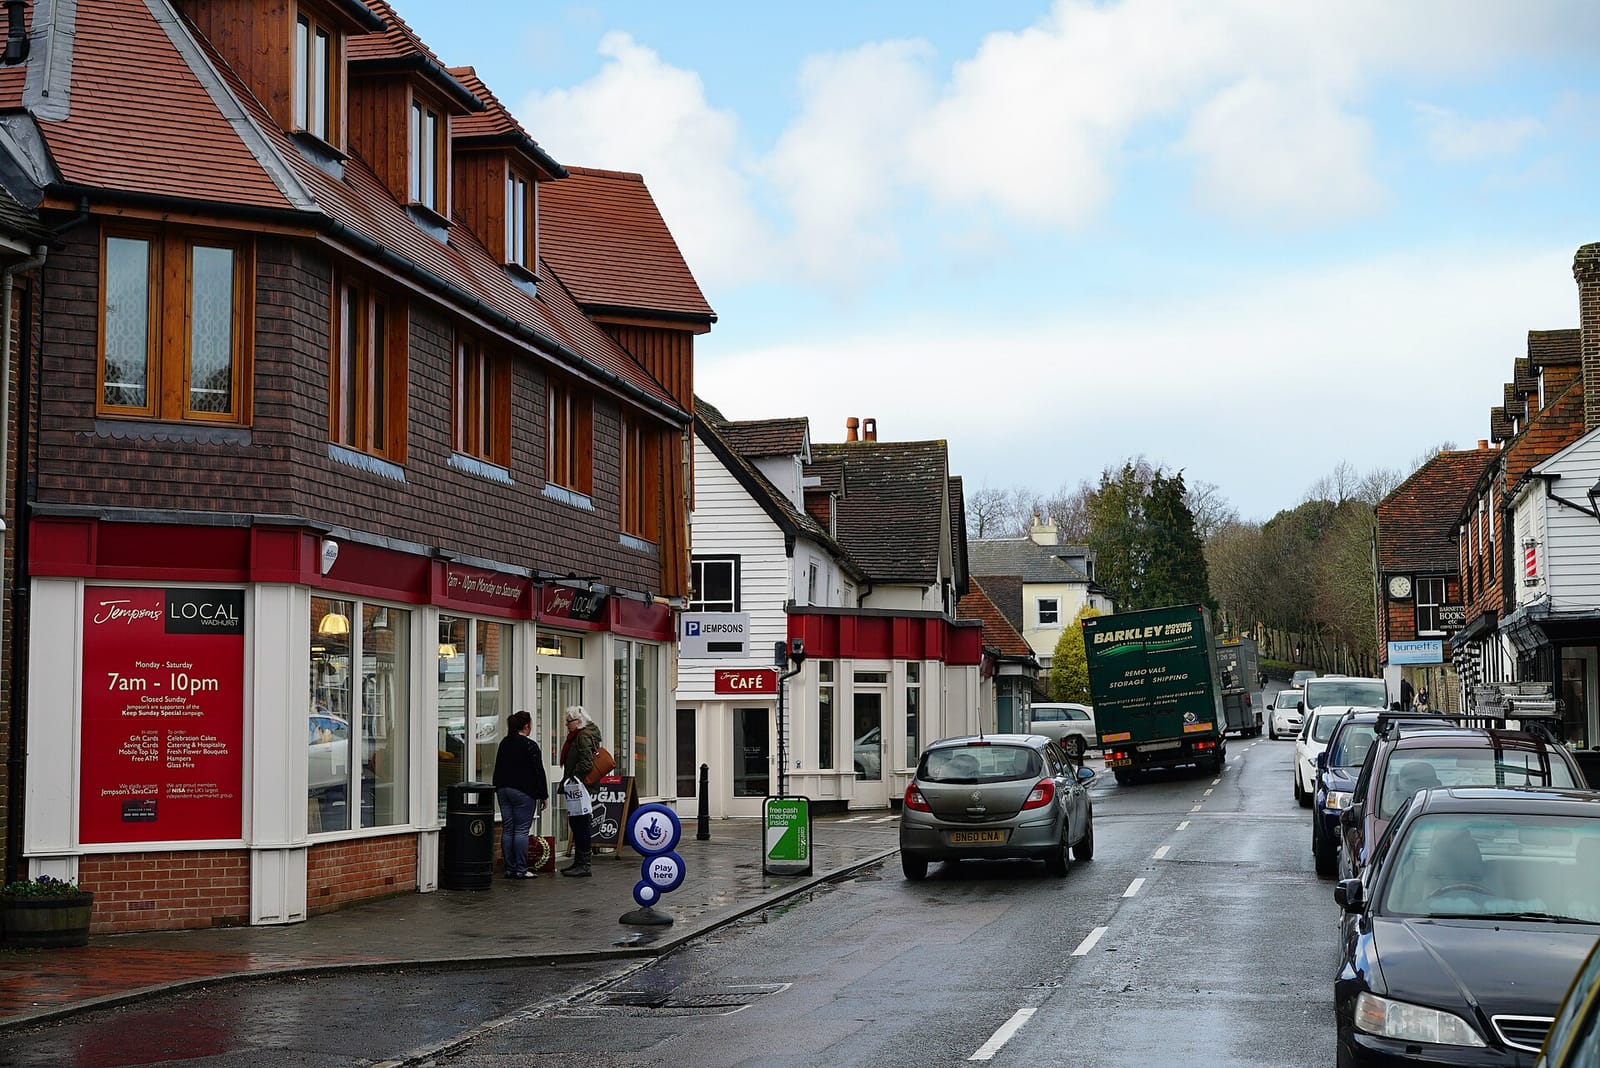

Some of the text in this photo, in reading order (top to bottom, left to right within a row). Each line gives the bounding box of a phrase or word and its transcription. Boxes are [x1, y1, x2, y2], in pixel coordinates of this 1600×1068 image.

[476, 578, 496, 597] Monday
[502, 583, 522, 602] Saturday
[94, 600, 239, 624] Jempson's LOCAL
[1440, 612, 1466, 620] BOOKS
[702, 624, 743, 633] JEMPSONS
[1165, 622, 1192, 630] MOVING
[1094, 626, 1164, 644] BARKLEY
[1165, 628, 1192, 636] GROUP
[1394, 642, 1438, 651] burnett's
[135, 661, 160, 669] Monday
[166, 661, 192, 670] Saturday
[108, 673, 146, 690] 7am
[171, 673, 218, 696] 10pm
[730, 675, 763, 689] CAFÉ
[1110, 674, 1188, 688] STORAGE SHIPPING
[164, 696, 186, 704] Sunday
